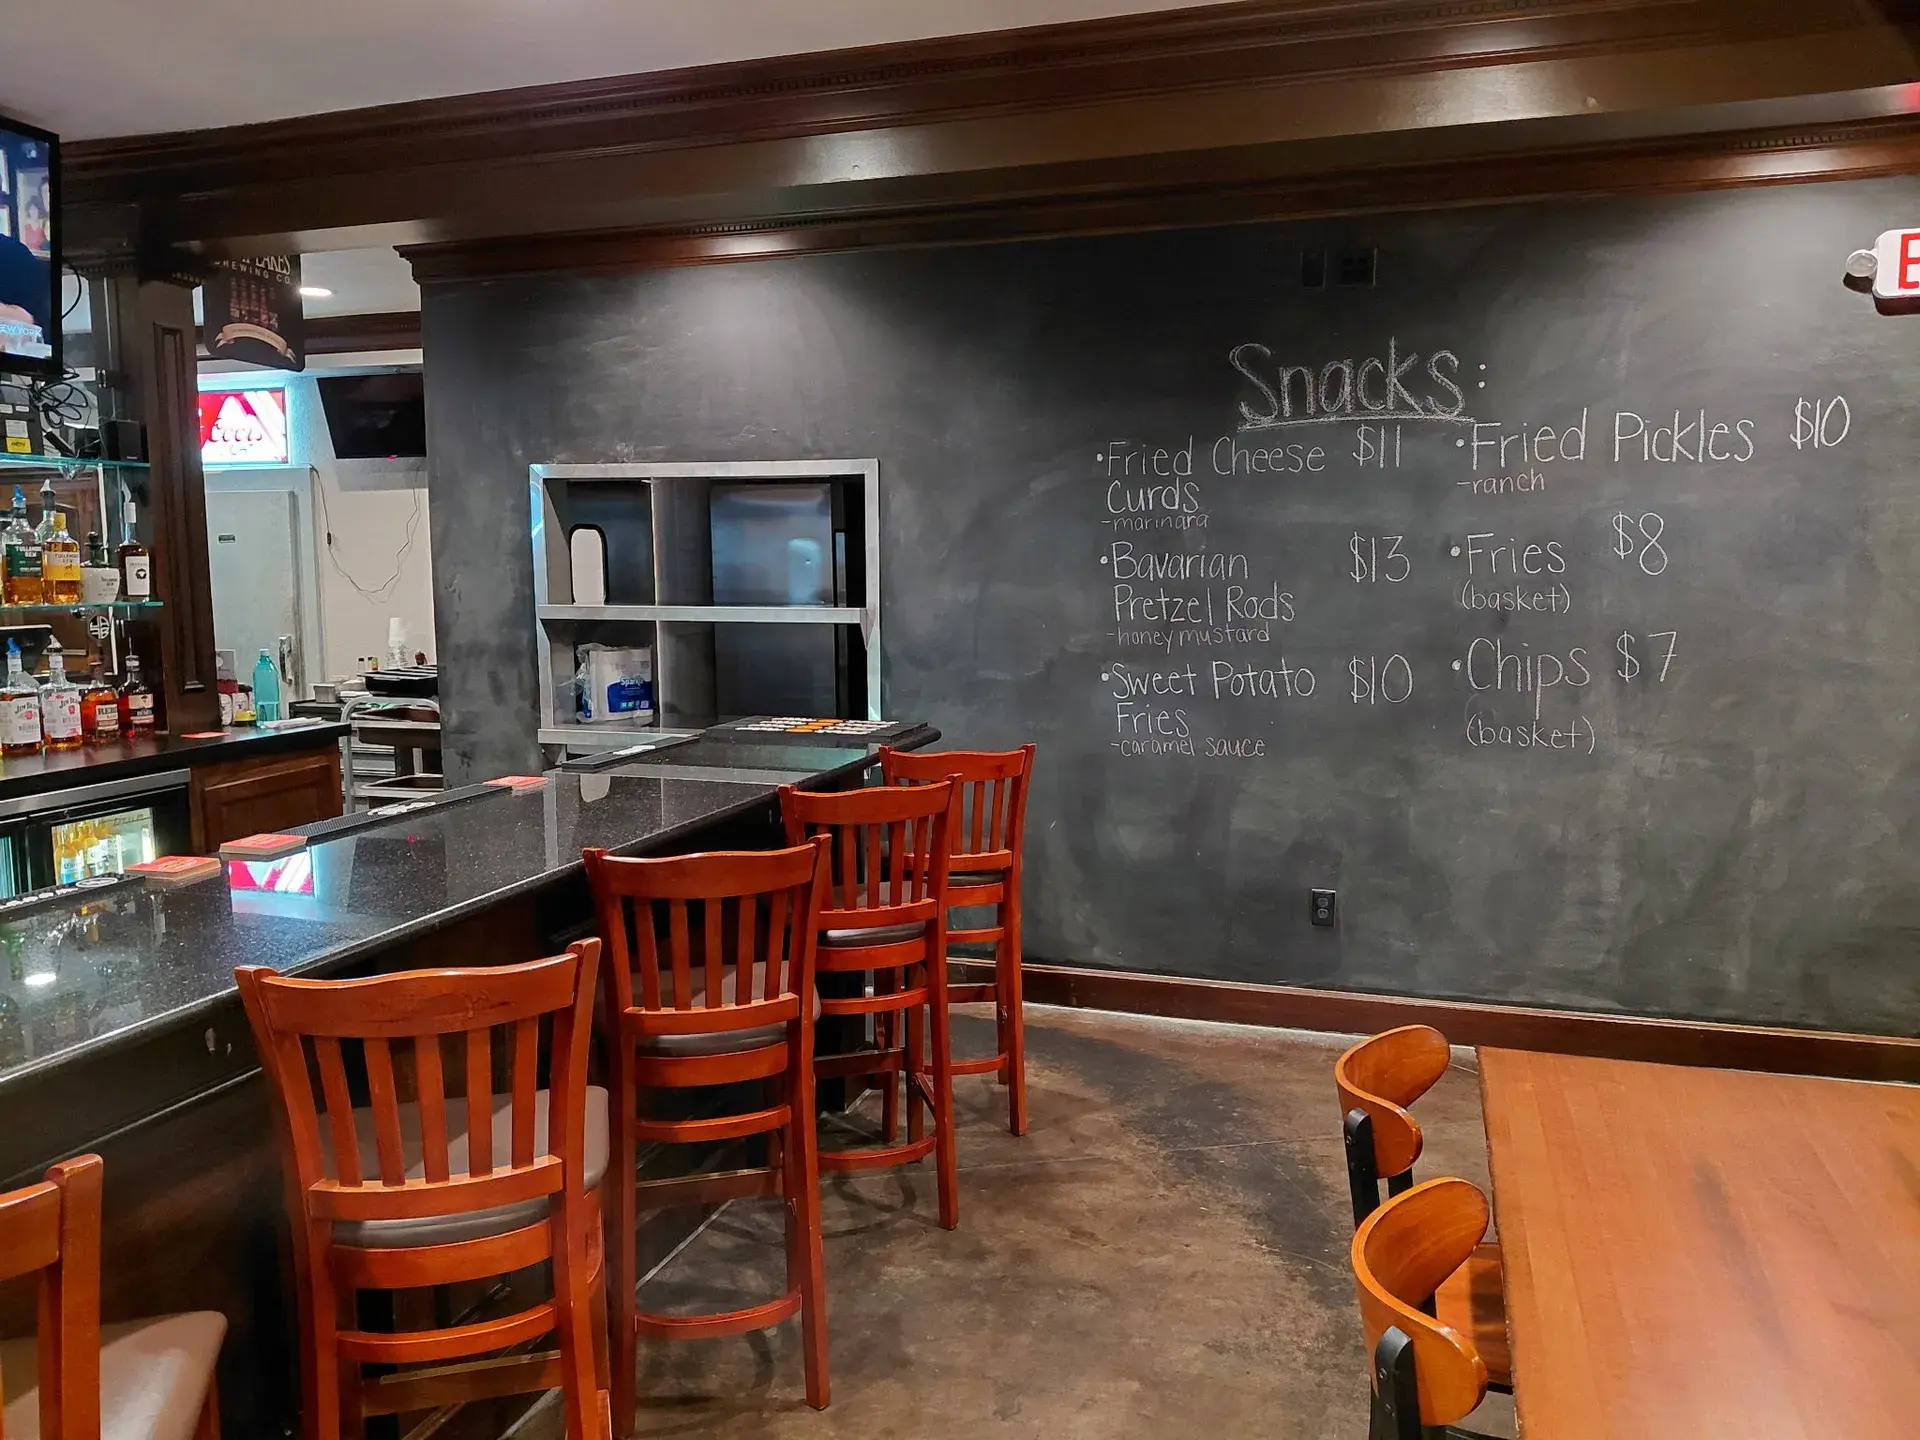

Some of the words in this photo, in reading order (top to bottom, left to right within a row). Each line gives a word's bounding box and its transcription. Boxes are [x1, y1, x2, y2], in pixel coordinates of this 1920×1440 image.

[1211, 436, 1326, 475] Cheese
[1352, 423, 1401, 469] $11
[1613, 408, 1756, 464] Pickles
[1789, 395, 1851, 450] $10
[1106, 479, 1201, 514] Curds
[1349, 532, 1411, 582] $13
[1611, 510, 1669, 576] $8
[1113, 583, 1213, 625] Pretzel
[1226, 580, 1296, 622] Rods
[1461, 579, 1571, 614] (basket)
[1179, 622, 1271, 644] mustard
[1211, 656, 1316, 700] Potato
[1349, 653, 1413, 705] $10
[1116, 702, 1191, 738] Fries
[1466, 714, 1596, 755] (basket)
[1204, 737, 1266, 758] sauce
